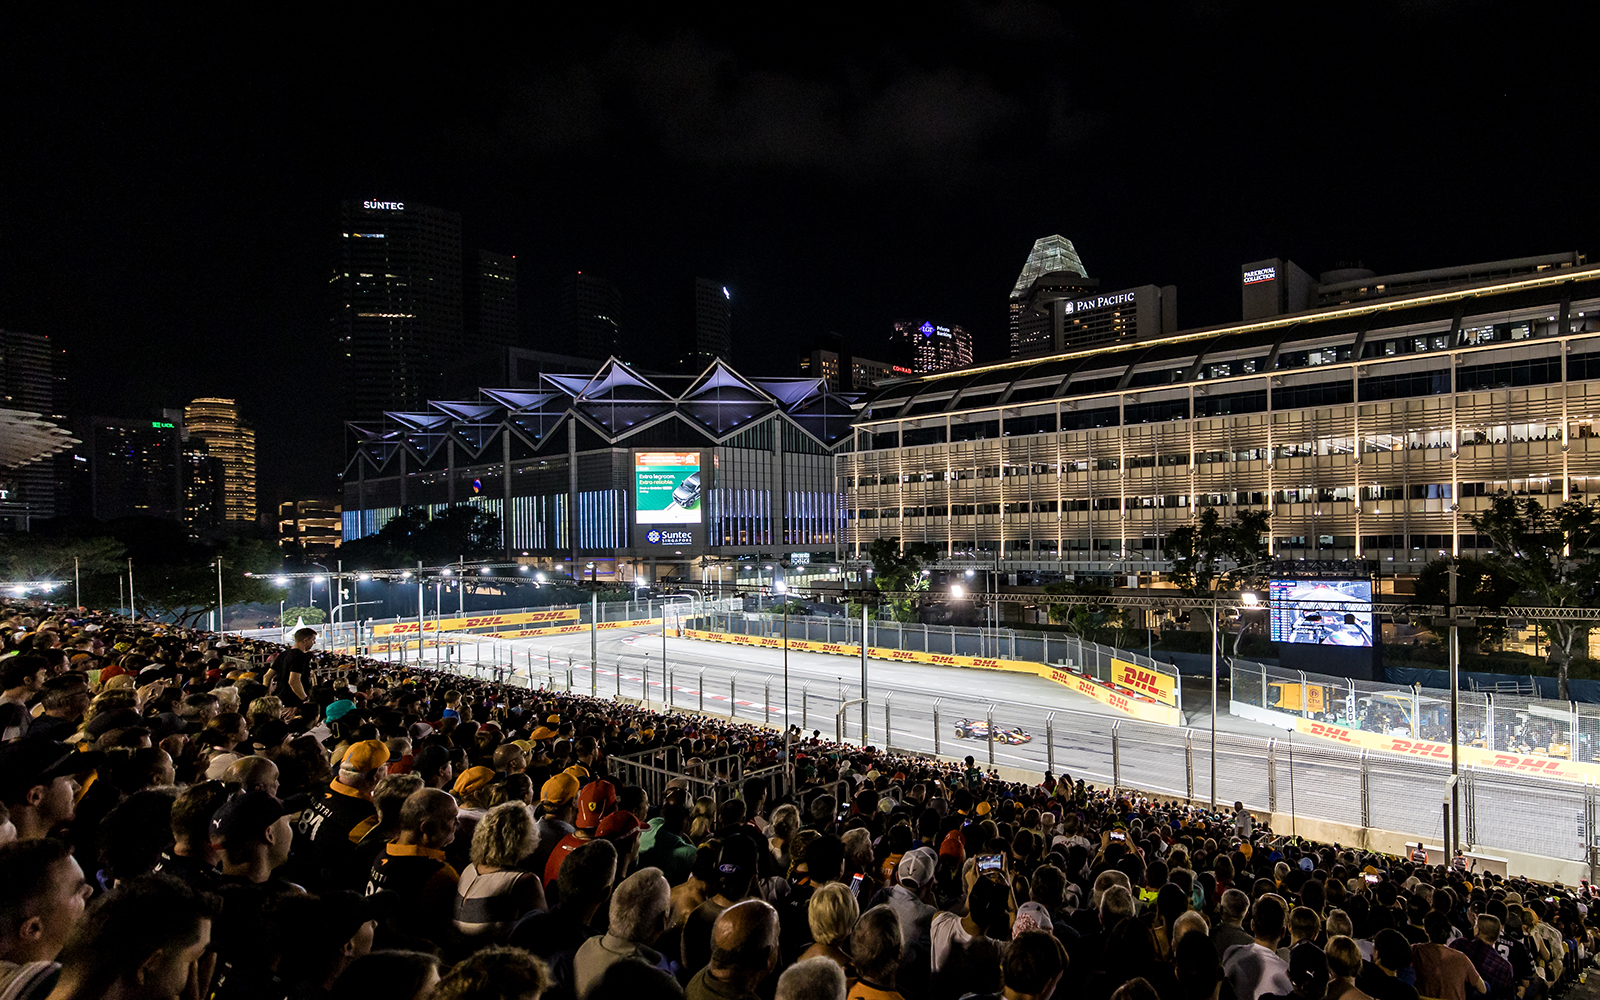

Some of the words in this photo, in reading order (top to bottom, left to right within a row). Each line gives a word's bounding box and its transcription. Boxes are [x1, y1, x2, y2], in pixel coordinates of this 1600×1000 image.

[363, 200, 405, 210] SUNTEC
[1077, 300, 1096, 311] PAN
[1097, 292, 1135, 307] PACIFIC
[661, 531, 692, 539] Suntec
[466, 616, 504, 627] DHL
[532, 612, 567, 622] DHL
[393, 622, 434, 634] DHL
[520, 629, 543, 637] DHL
[734, 635, 750, 643] DHL
[761, 638, 778, 646] DHL
[790, 641, 809, 649] DHL
[822, 644, 842, 652] DHL
[892, 651, 915, 660] DHL
[931, 655, 955, 664] DHL
[973, 659, 998, 668] DHL
[1052, 670, 1068, 684] DHL
[1124, 666, 1159, 695] DHL
[1079, 681, 1096, 697] DHL
[1109, 694, 1129, 712] DHL
[1310, 723, 1351, 742] DHL
[1391, 739, 1450, 759] DHL
[1493, 754, 1564, 777] DHL
